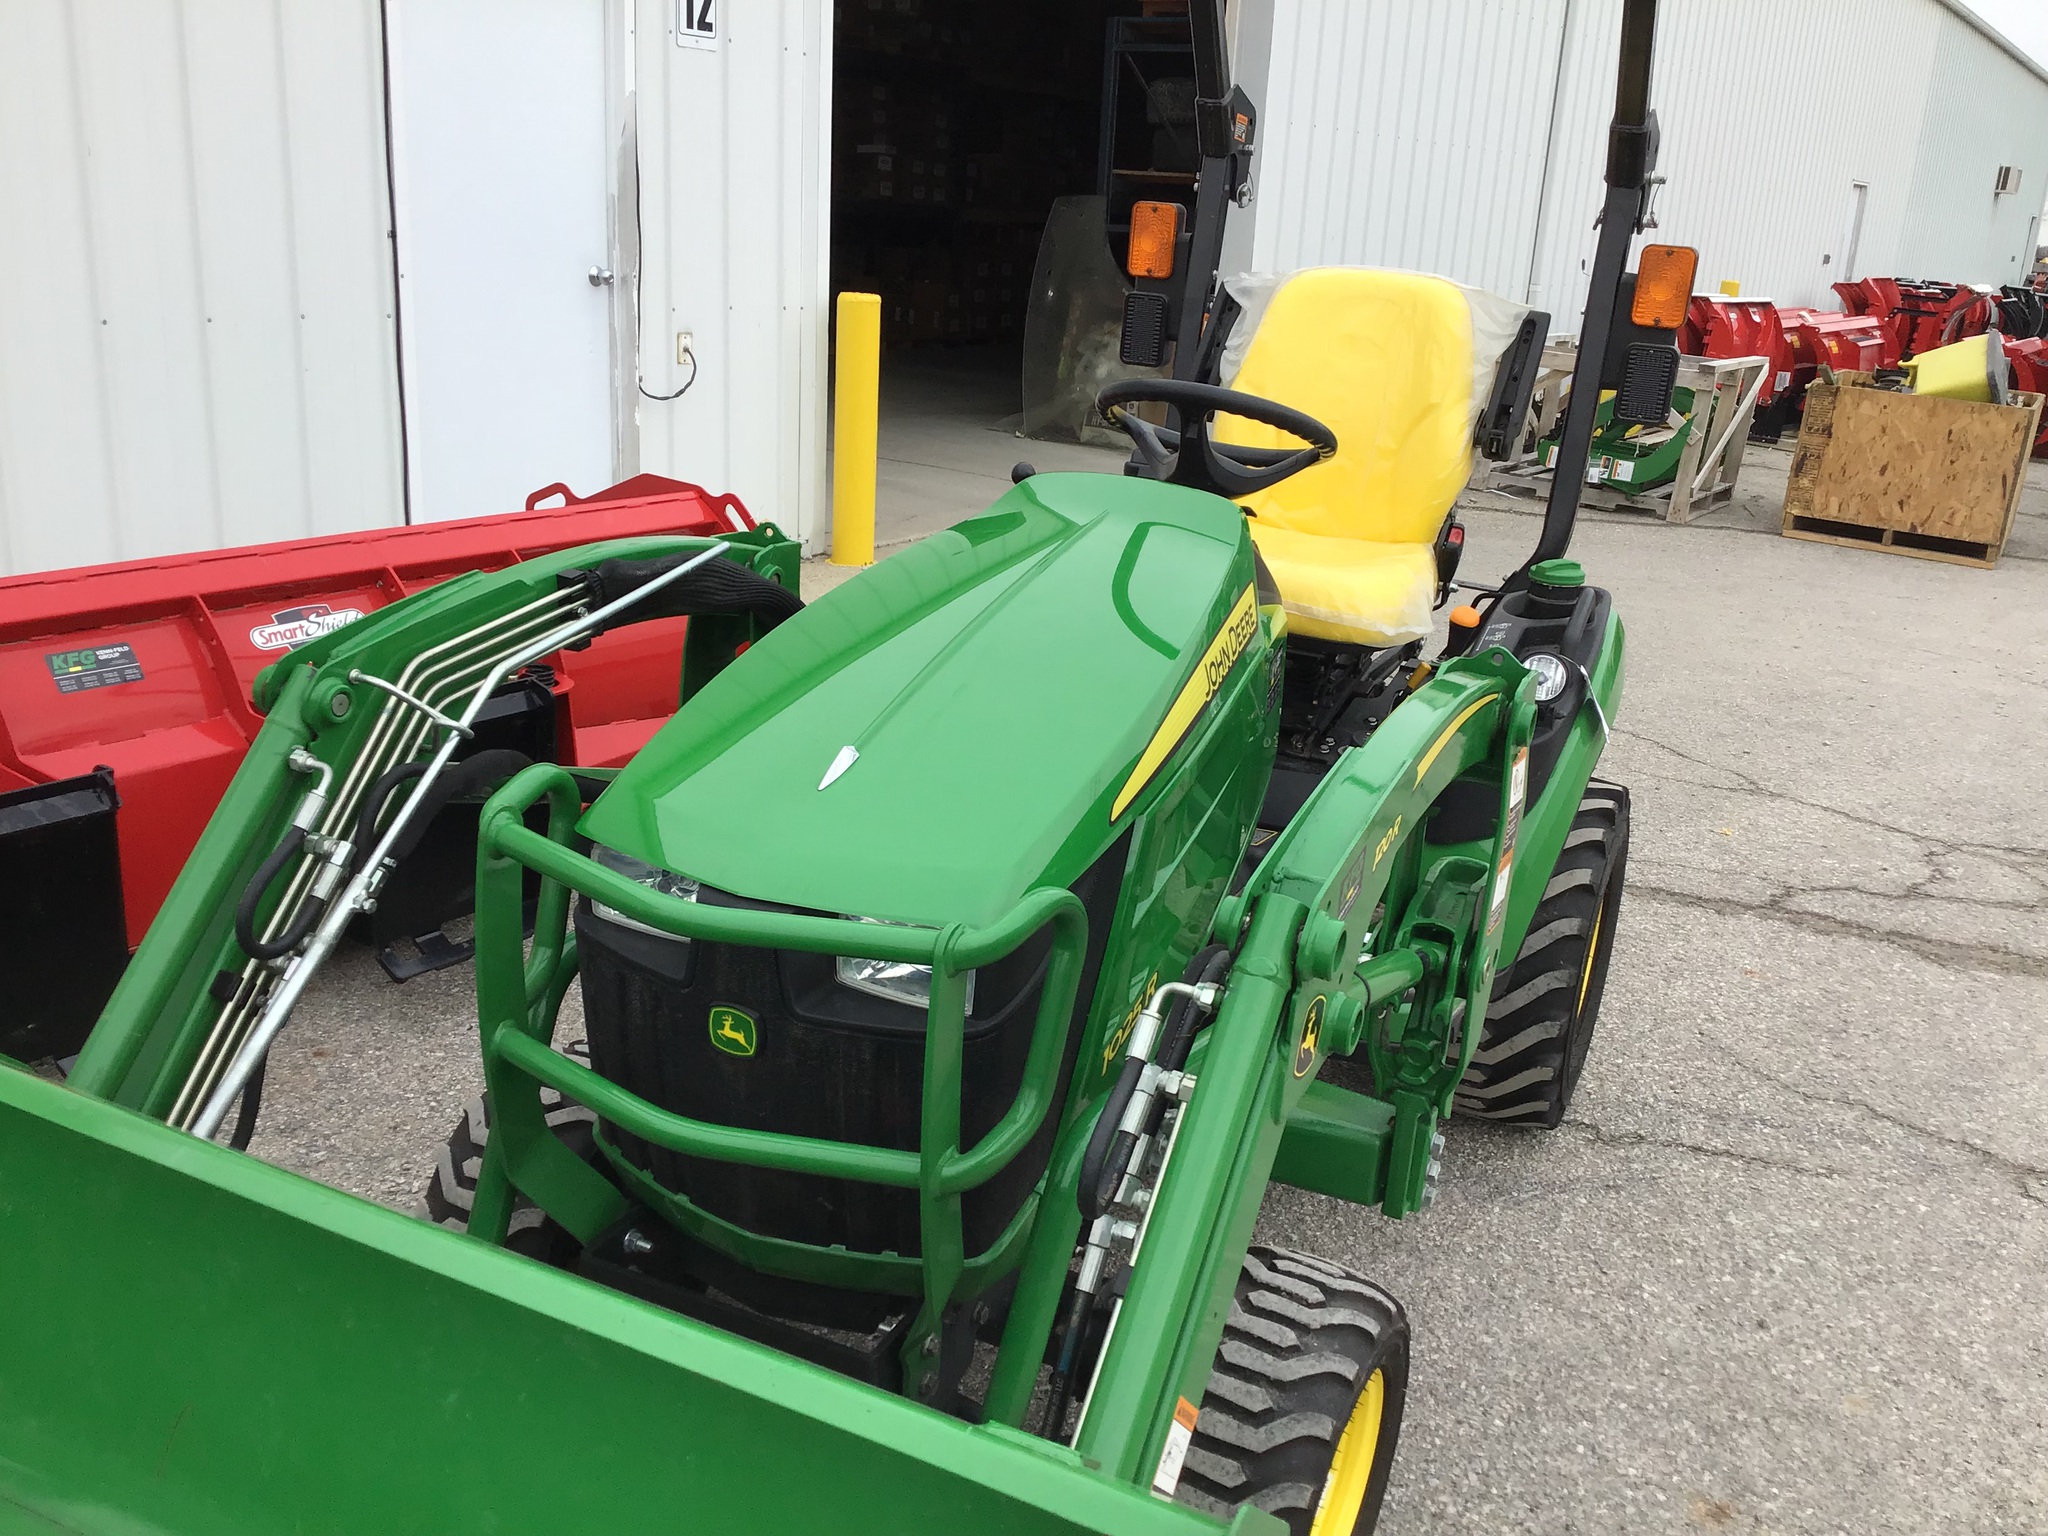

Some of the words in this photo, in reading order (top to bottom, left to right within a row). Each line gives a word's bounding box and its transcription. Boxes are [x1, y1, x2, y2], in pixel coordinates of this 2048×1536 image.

[686, 0, 713, 32] 12
[52, 650, 96, 669] KFG
[95, 646, 129, 655] KENN-FELD
[98, 652, 120, 660] GROUP
[1204, 641, 1232, 699] JOHN
[1228, 603, 1256, 657] DEERE
